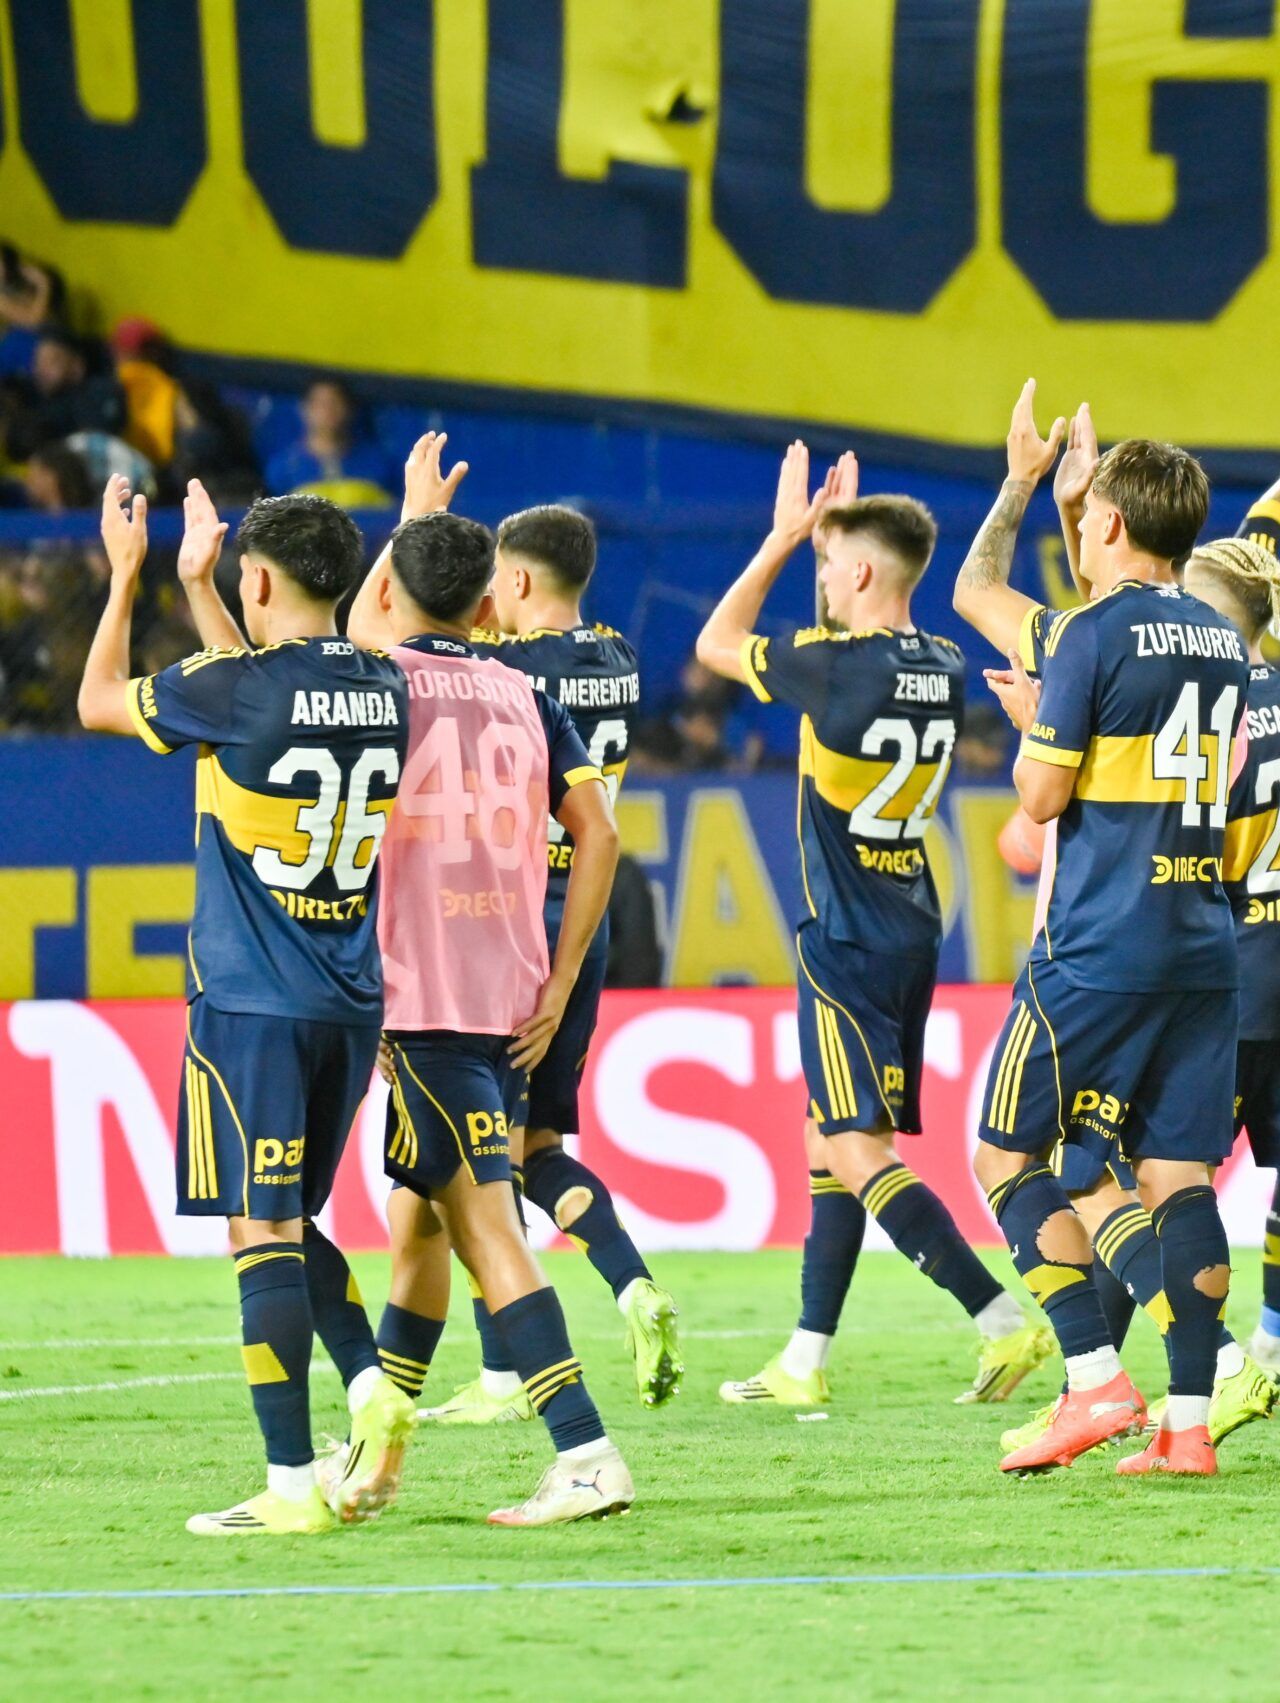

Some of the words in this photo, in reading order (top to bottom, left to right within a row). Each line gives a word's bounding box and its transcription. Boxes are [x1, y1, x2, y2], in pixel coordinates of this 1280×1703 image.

[1130, 622, 1244, 663] ZUFIAURRE
[559, 671, 639, 708] MERENTIE
[895, 672, 949, 702] ZENON
[289, 690, 398, 727] ARANDA
[1153, 682, 1238, 829] 41
[402, 717, 535, 870] 48
[848, 718, 956, 839] 22
[252, 747, 400, 890] 36
[465, 1110, 509, 1146] pa
